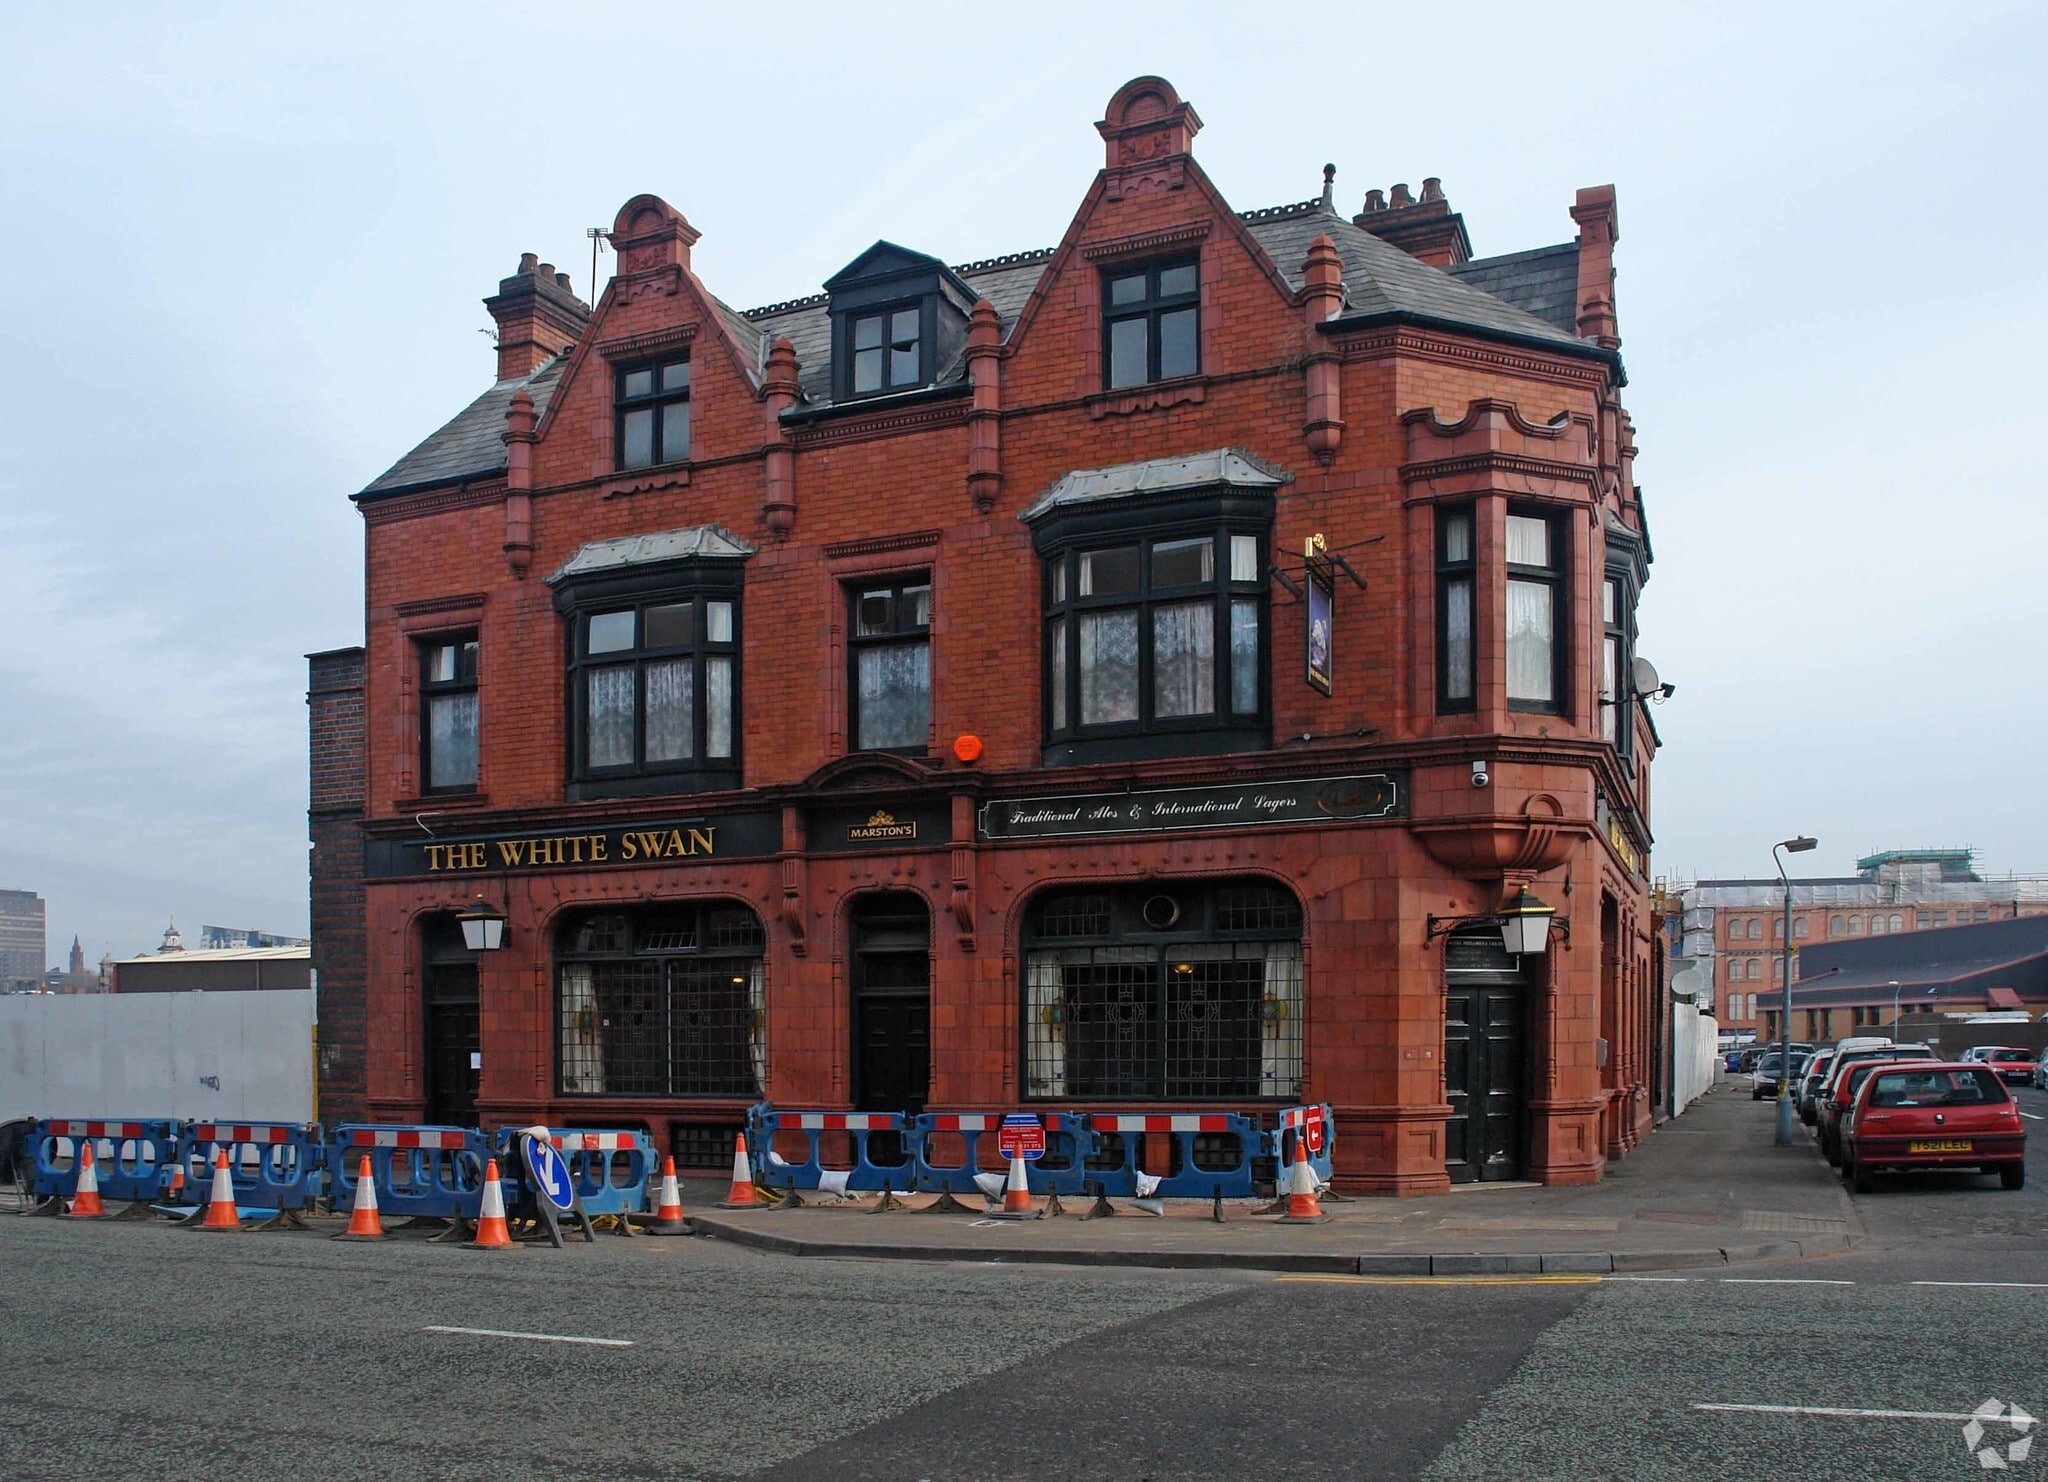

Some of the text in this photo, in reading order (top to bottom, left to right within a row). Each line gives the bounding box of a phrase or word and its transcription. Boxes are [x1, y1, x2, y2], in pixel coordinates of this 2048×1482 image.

[1009, 794, 1297, 825] Traditional Ales & International Lagers
[850, 824, 913, 839] MARSTON'S
[423, 826, 717, 871] THE WHITE SWAN
